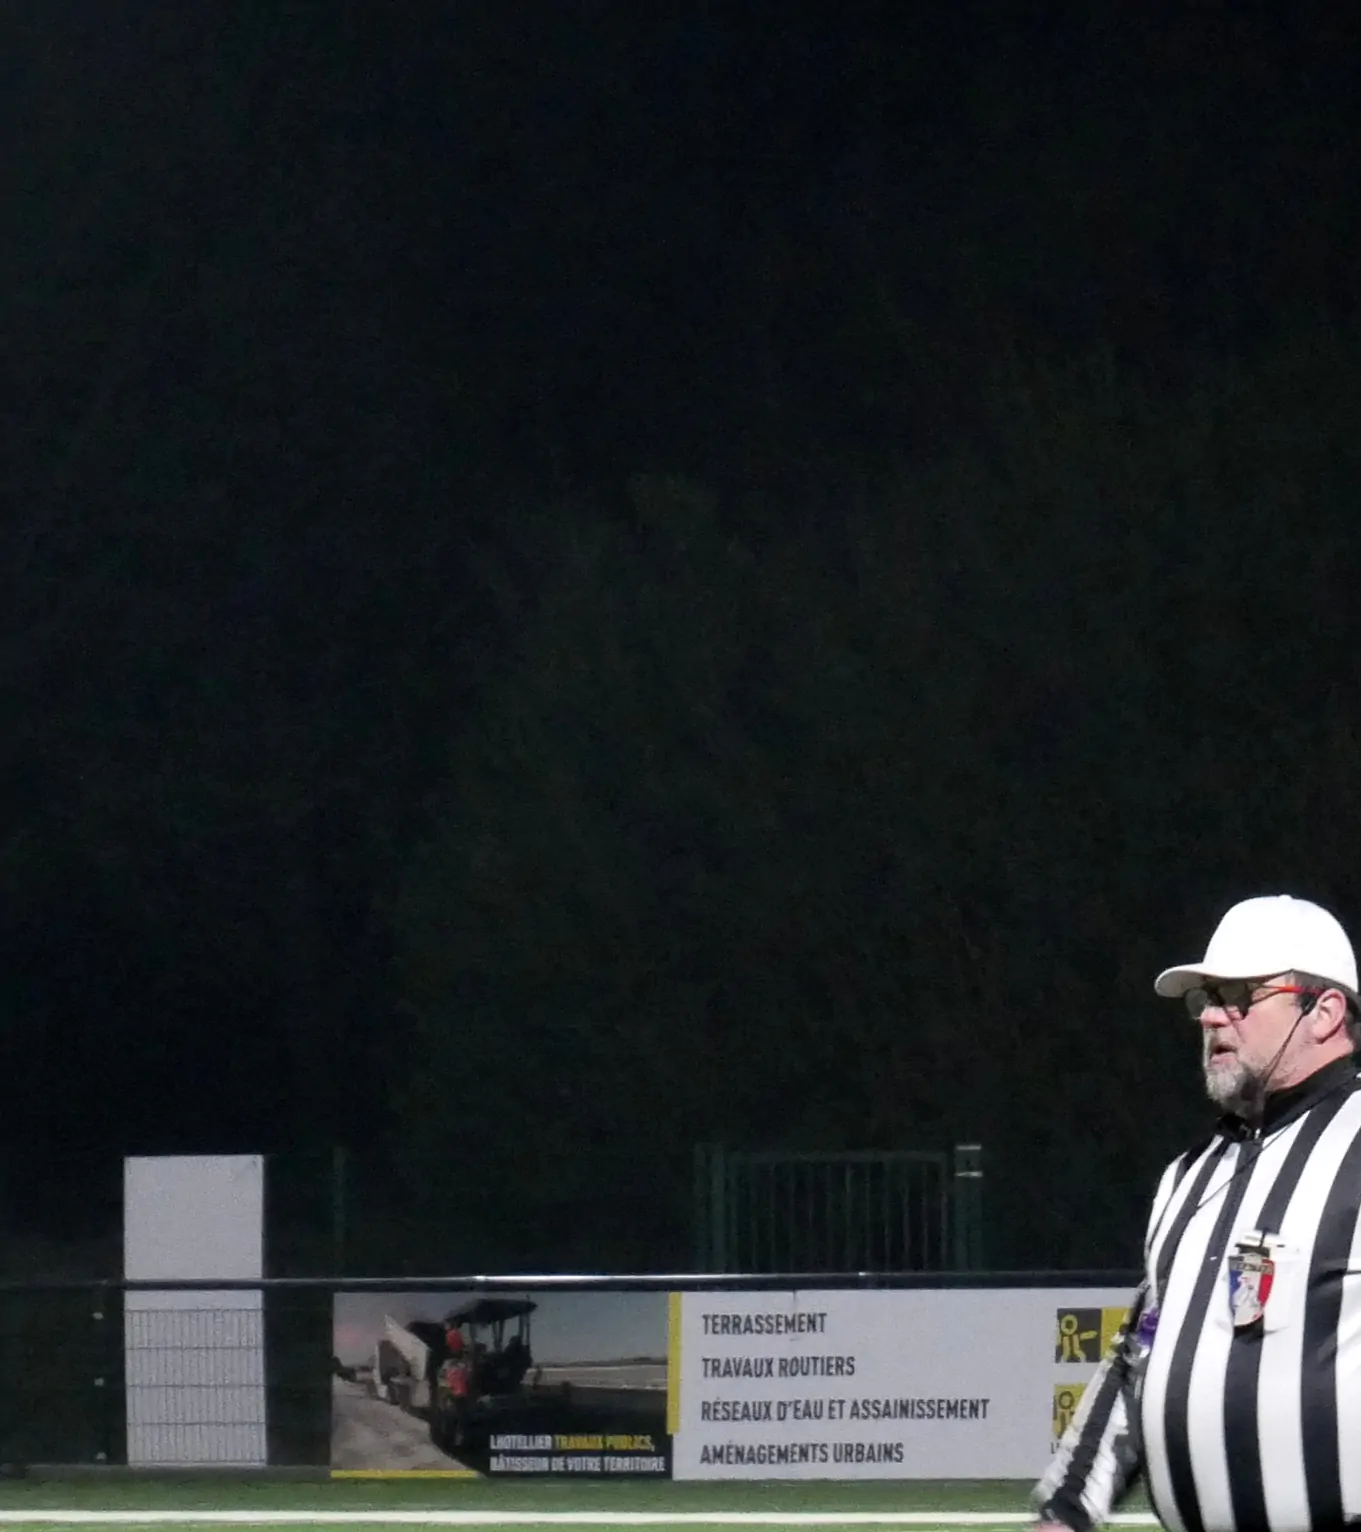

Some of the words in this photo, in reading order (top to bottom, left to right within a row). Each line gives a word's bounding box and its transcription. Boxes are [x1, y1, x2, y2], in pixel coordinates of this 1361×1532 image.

[702, 1313, 828, 1336] TERRASSEMENT
[701, 1356, 774, 1379] TRAVAUX
[778, 1356, 856, 1378] ROUTIERS
[701, 1397, 772, 1422] RÉSEAUX
[776, 1399, 824, 1420] D'EAU
[827, 1399, 847, 1420] ET
[849, 1399, 990, 1420] ASSAINISSEMENT
[700, 1440, 829, 1466] AMÉNAGEMENTS
[832, 1442, 905, 1464] URBAINS
